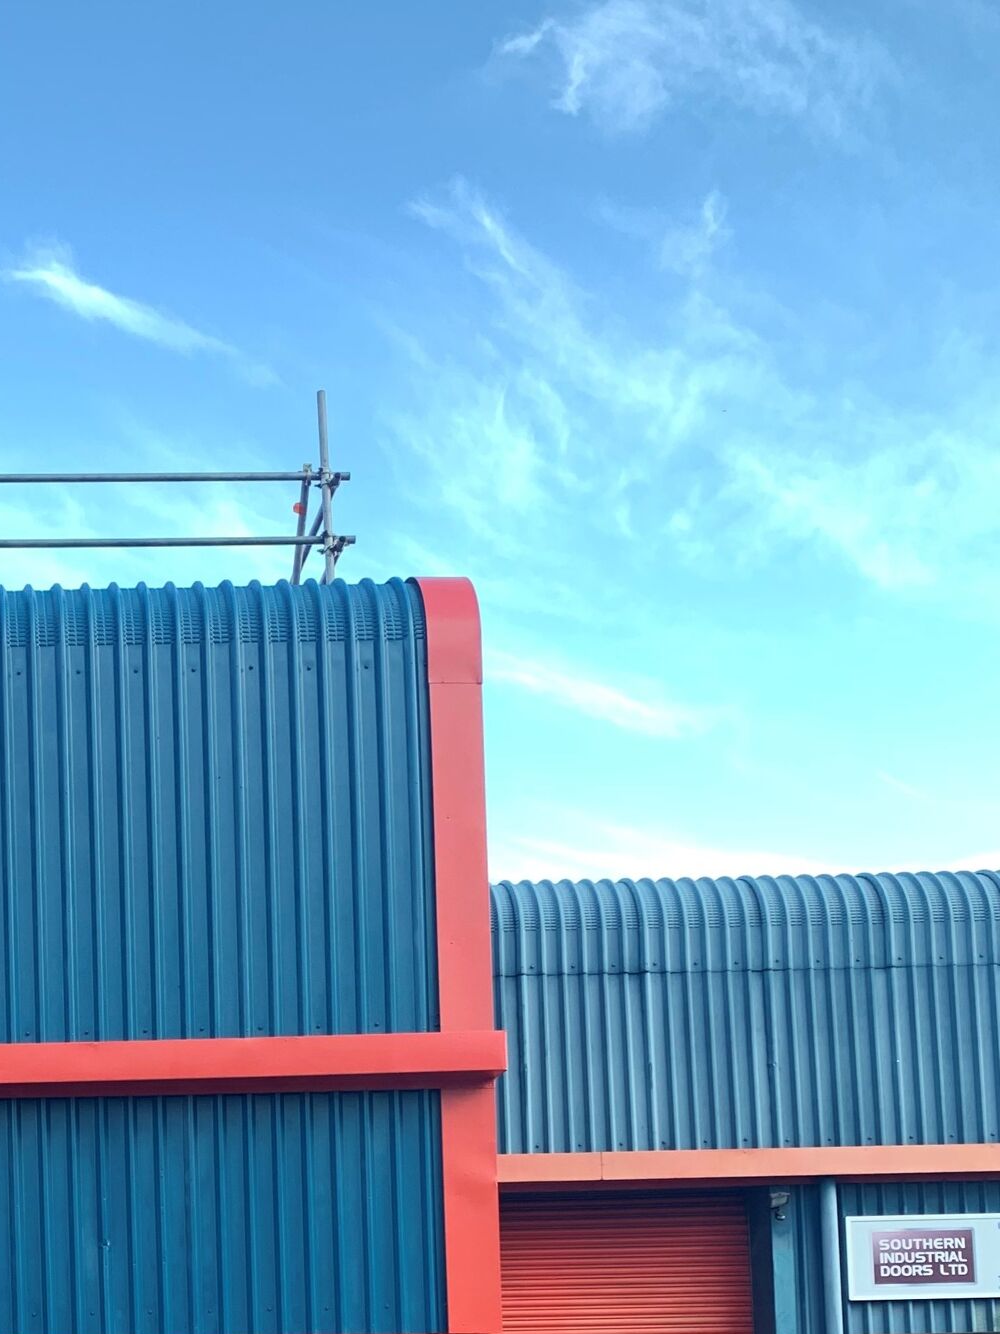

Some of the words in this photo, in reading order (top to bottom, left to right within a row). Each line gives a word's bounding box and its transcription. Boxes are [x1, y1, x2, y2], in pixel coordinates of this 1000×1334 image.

[879, 1237, 966, 1250] SOUTHERN
[880, 1251, 967, 1264] INDUSTRIAL
[880, 1264, 934, 1277] DOORS
[940, 1263, 968, 1276] LTD
